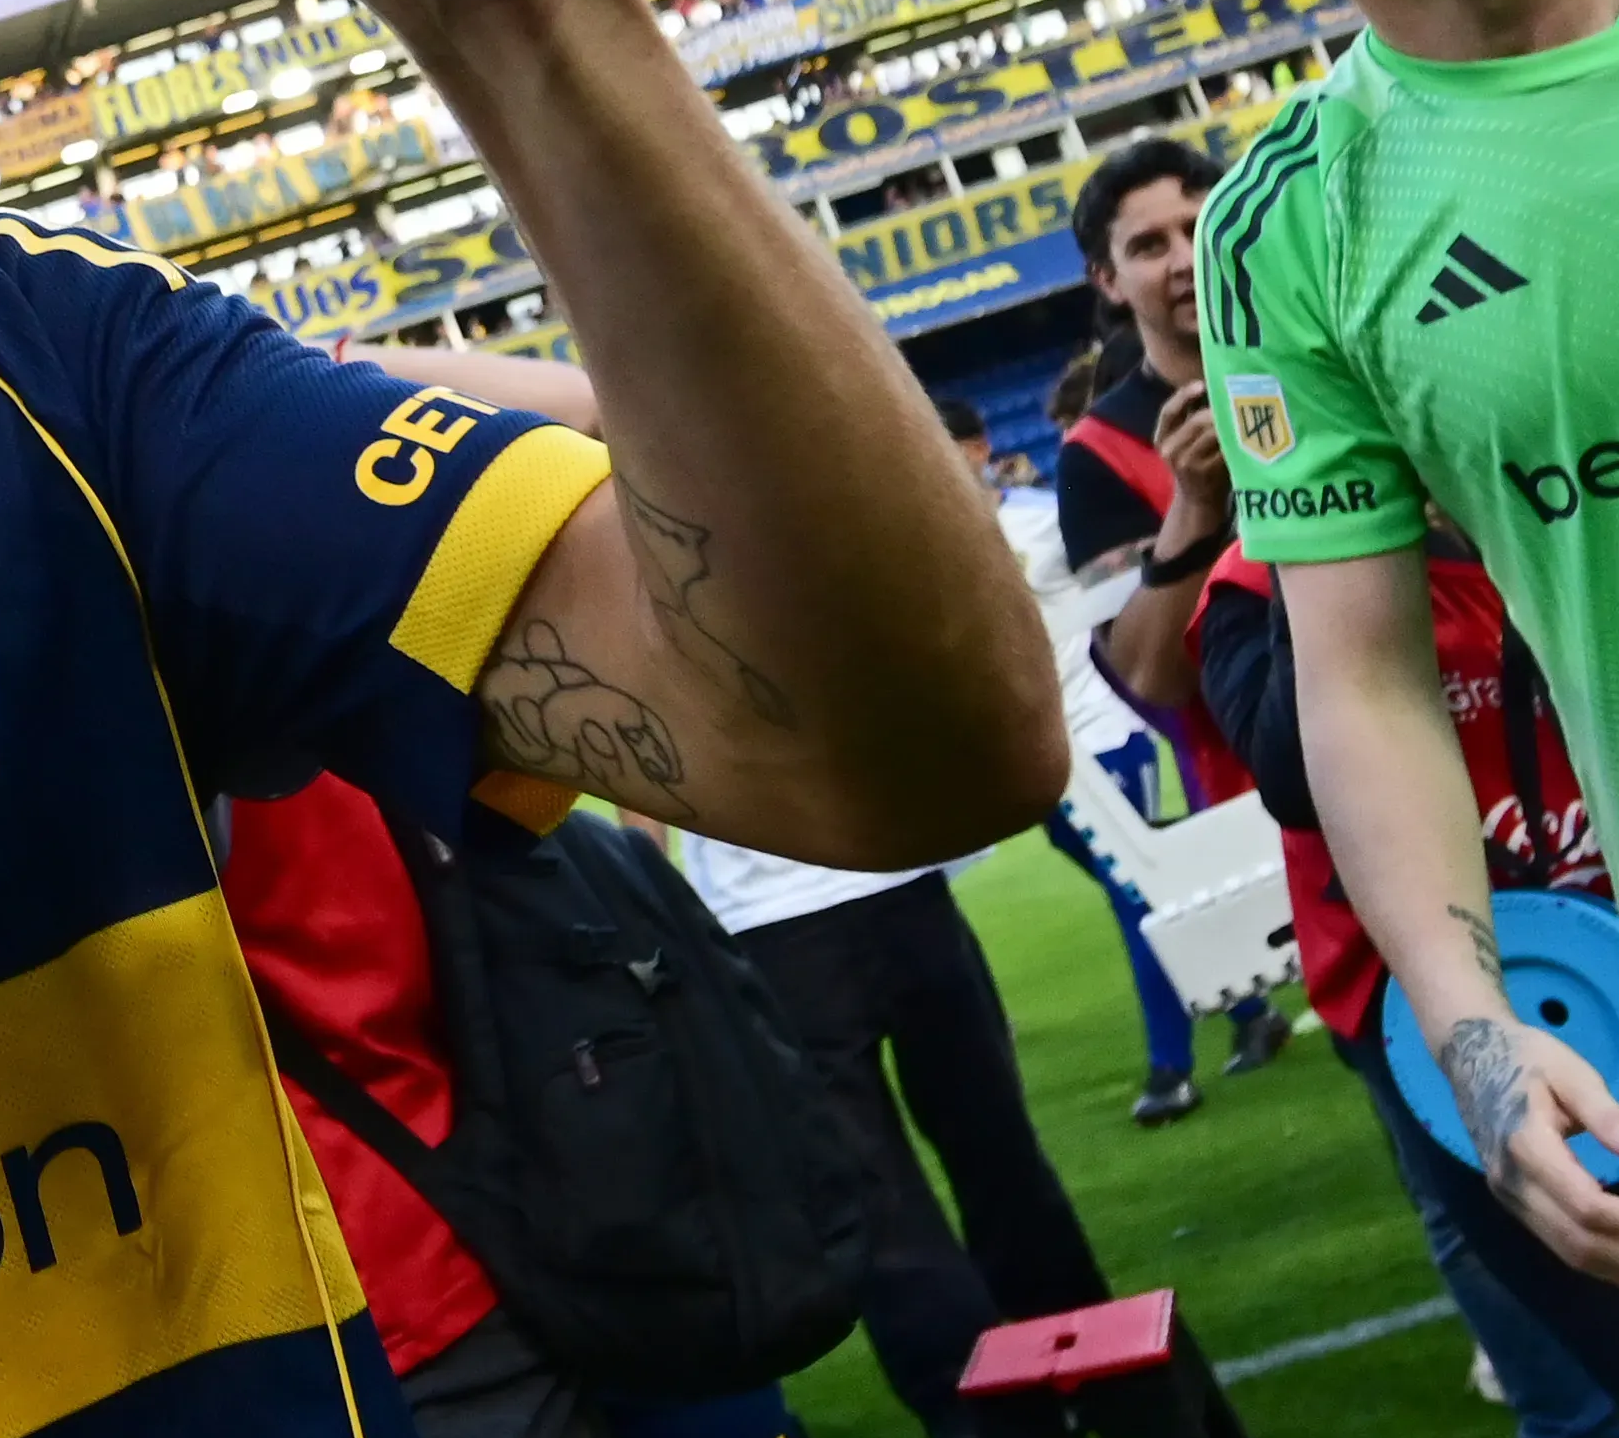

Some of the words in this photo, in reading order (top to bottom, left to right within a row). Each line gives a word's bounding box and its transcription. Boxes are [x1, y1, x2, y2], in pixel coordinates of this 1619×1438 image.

[838, 178, 1073, 289] NIORS
[354, 385, 501, 507] CET
[1232, 478, 1379, 521] TROGAR
